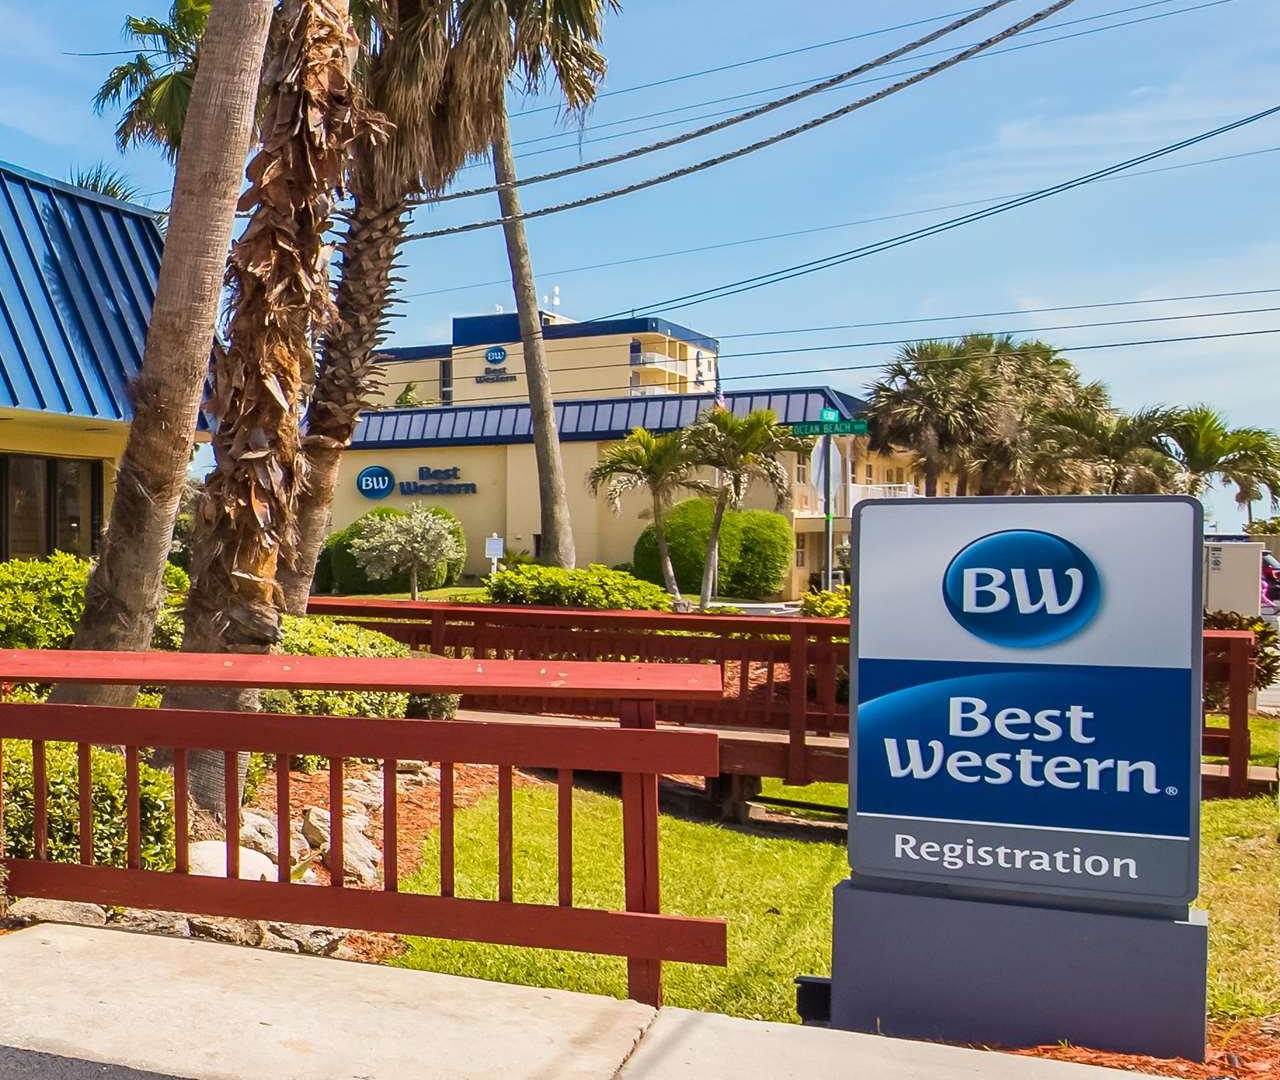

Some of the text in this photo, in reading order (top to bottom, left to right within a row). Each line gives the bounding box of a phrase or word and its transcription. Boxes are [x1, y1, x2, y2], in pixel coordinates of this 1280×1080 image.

[793, 424, 820, 435] OCEAN
[823, 423, 851, 434] BEACH
[362, 477, 389, 489] BW
[962, 567, 1084, 615] BW
[948, 696, 1096, 745] Best
[894, 834, 1138, 879] Registration
